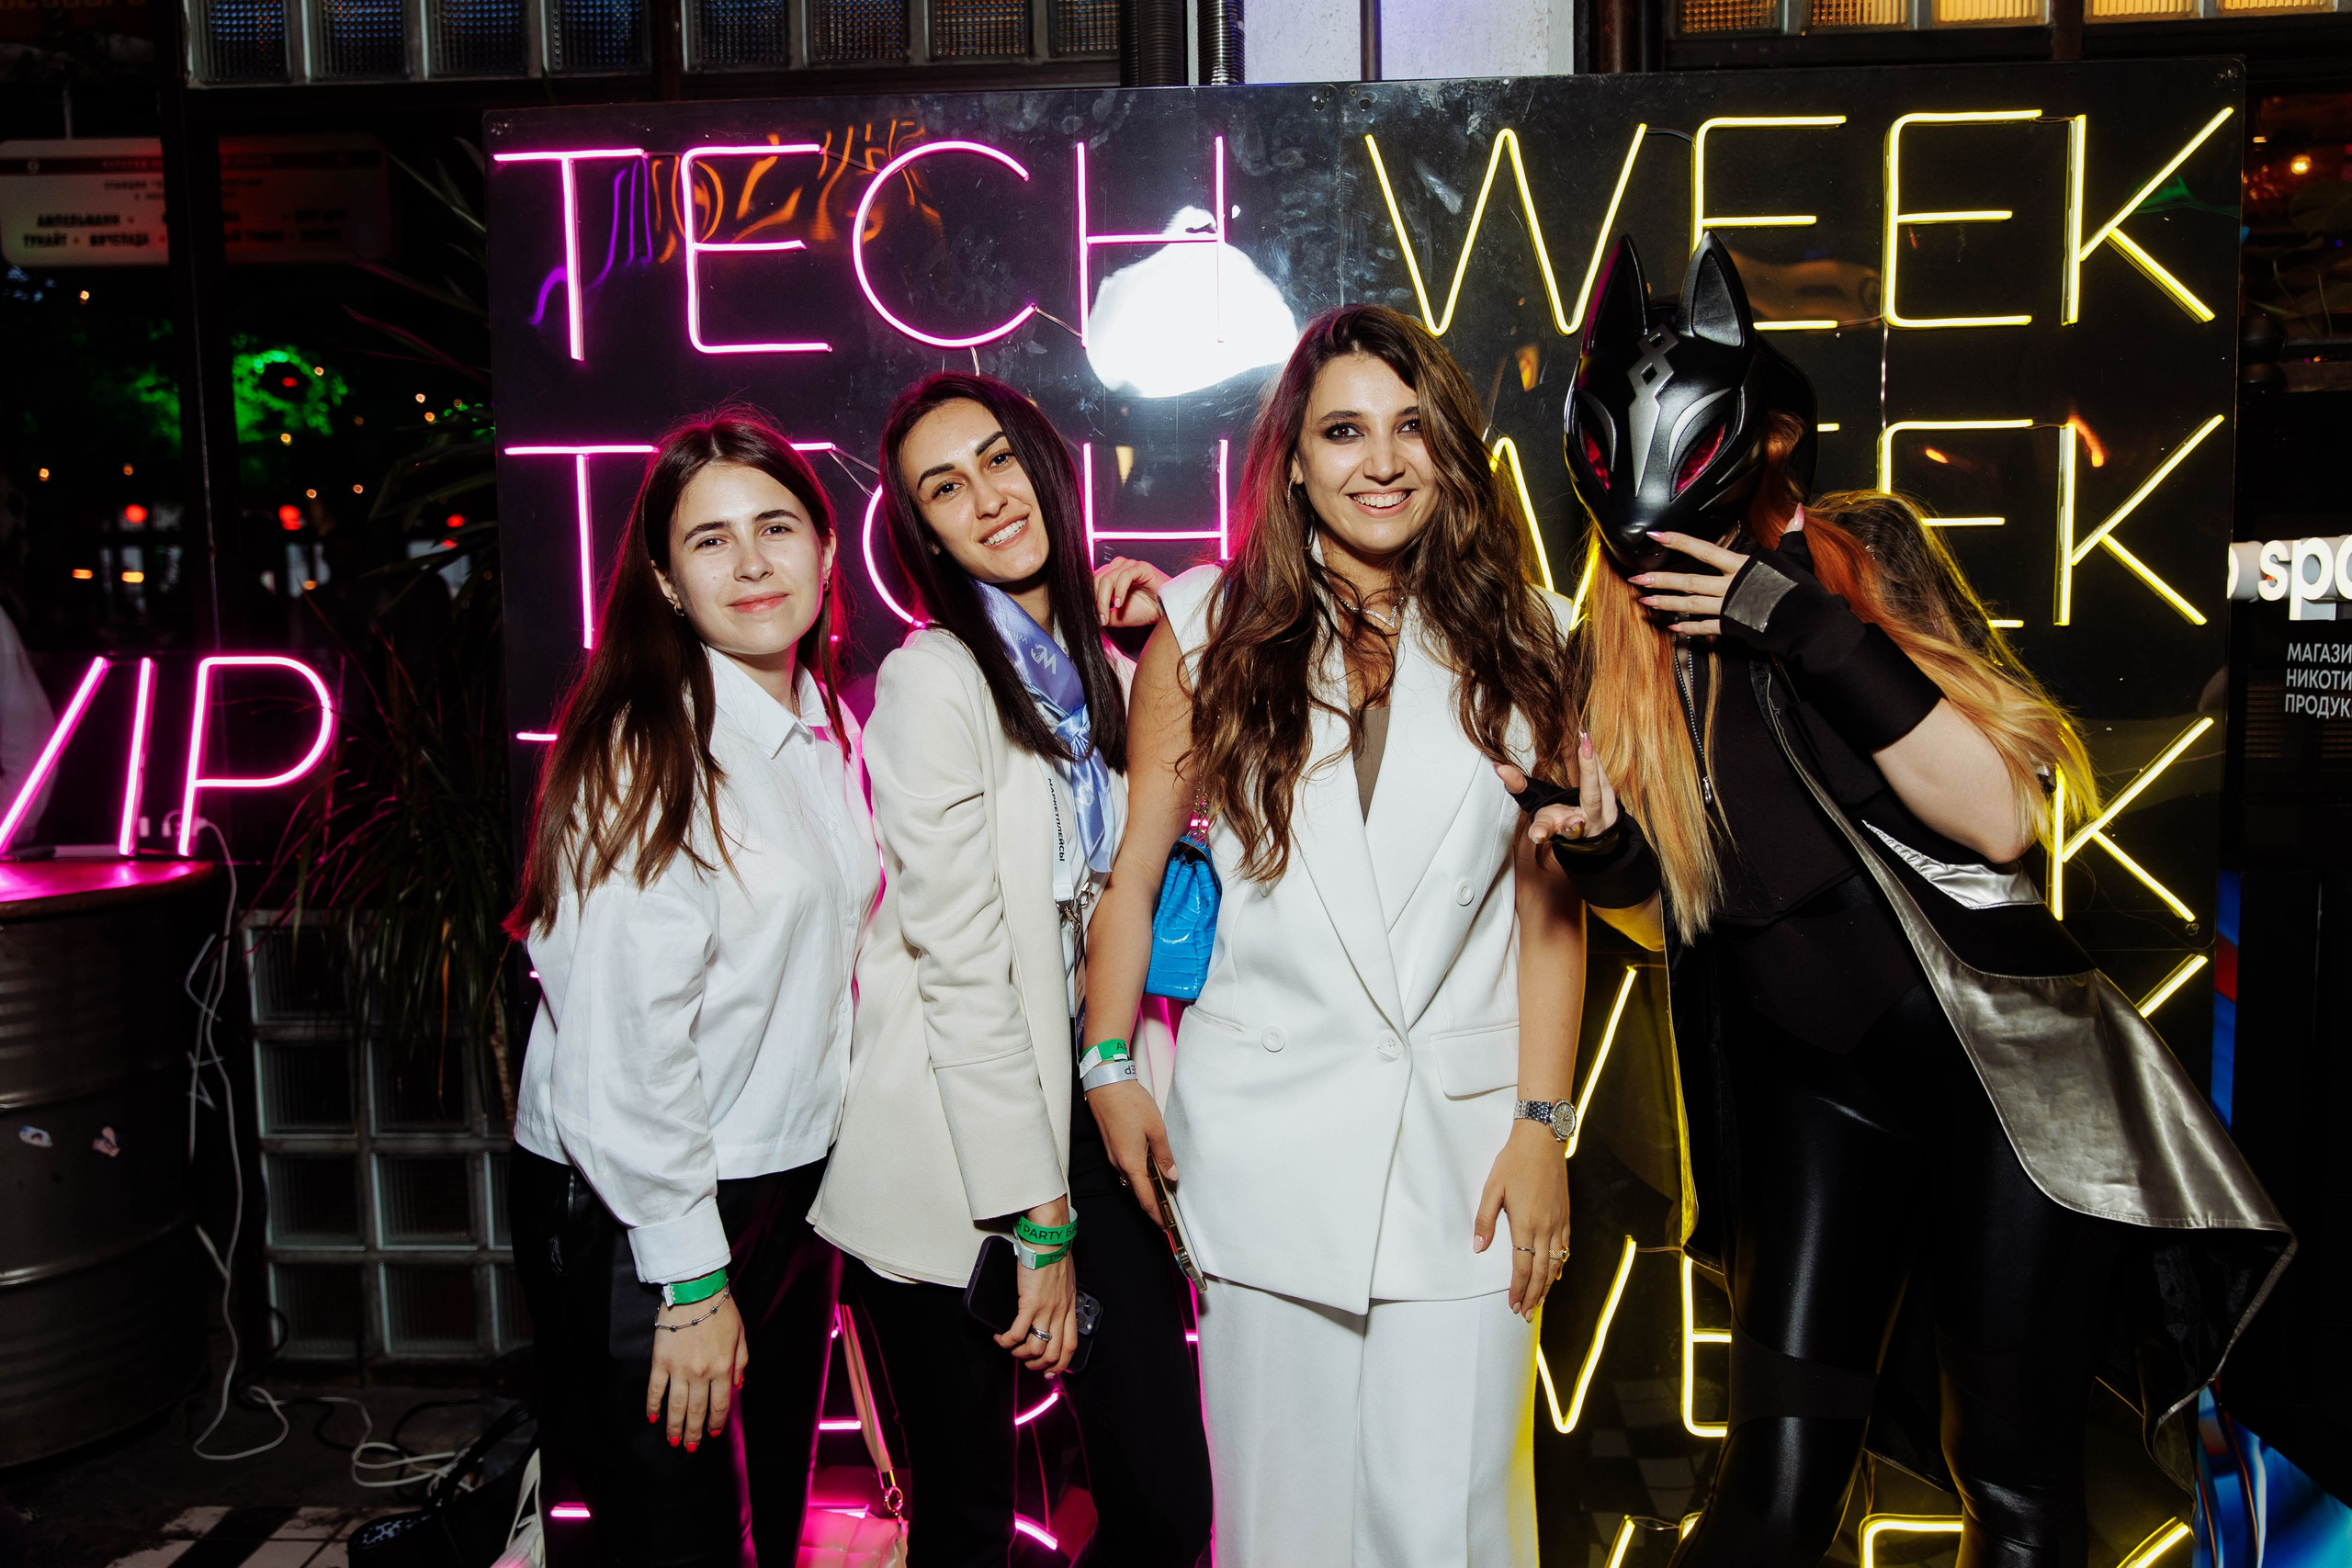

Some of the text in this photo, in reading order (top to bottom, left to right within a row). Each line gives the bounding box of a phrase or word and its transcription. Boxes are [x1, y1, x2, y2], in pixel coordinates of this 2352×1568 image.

[492, 107, 2233, 362] TECH WEEK
[2287, 642, 2352, 664] МАГАЗИ
[2286, 668, 2352, 691] НИКОТИ
[2284, 694, 2352, 719] ПРОДУК
[1047, 777, 1066, 863] МАРКЕТПЛЕЙСЫ
[1023, 1224, 1064, 1241] PARTY
